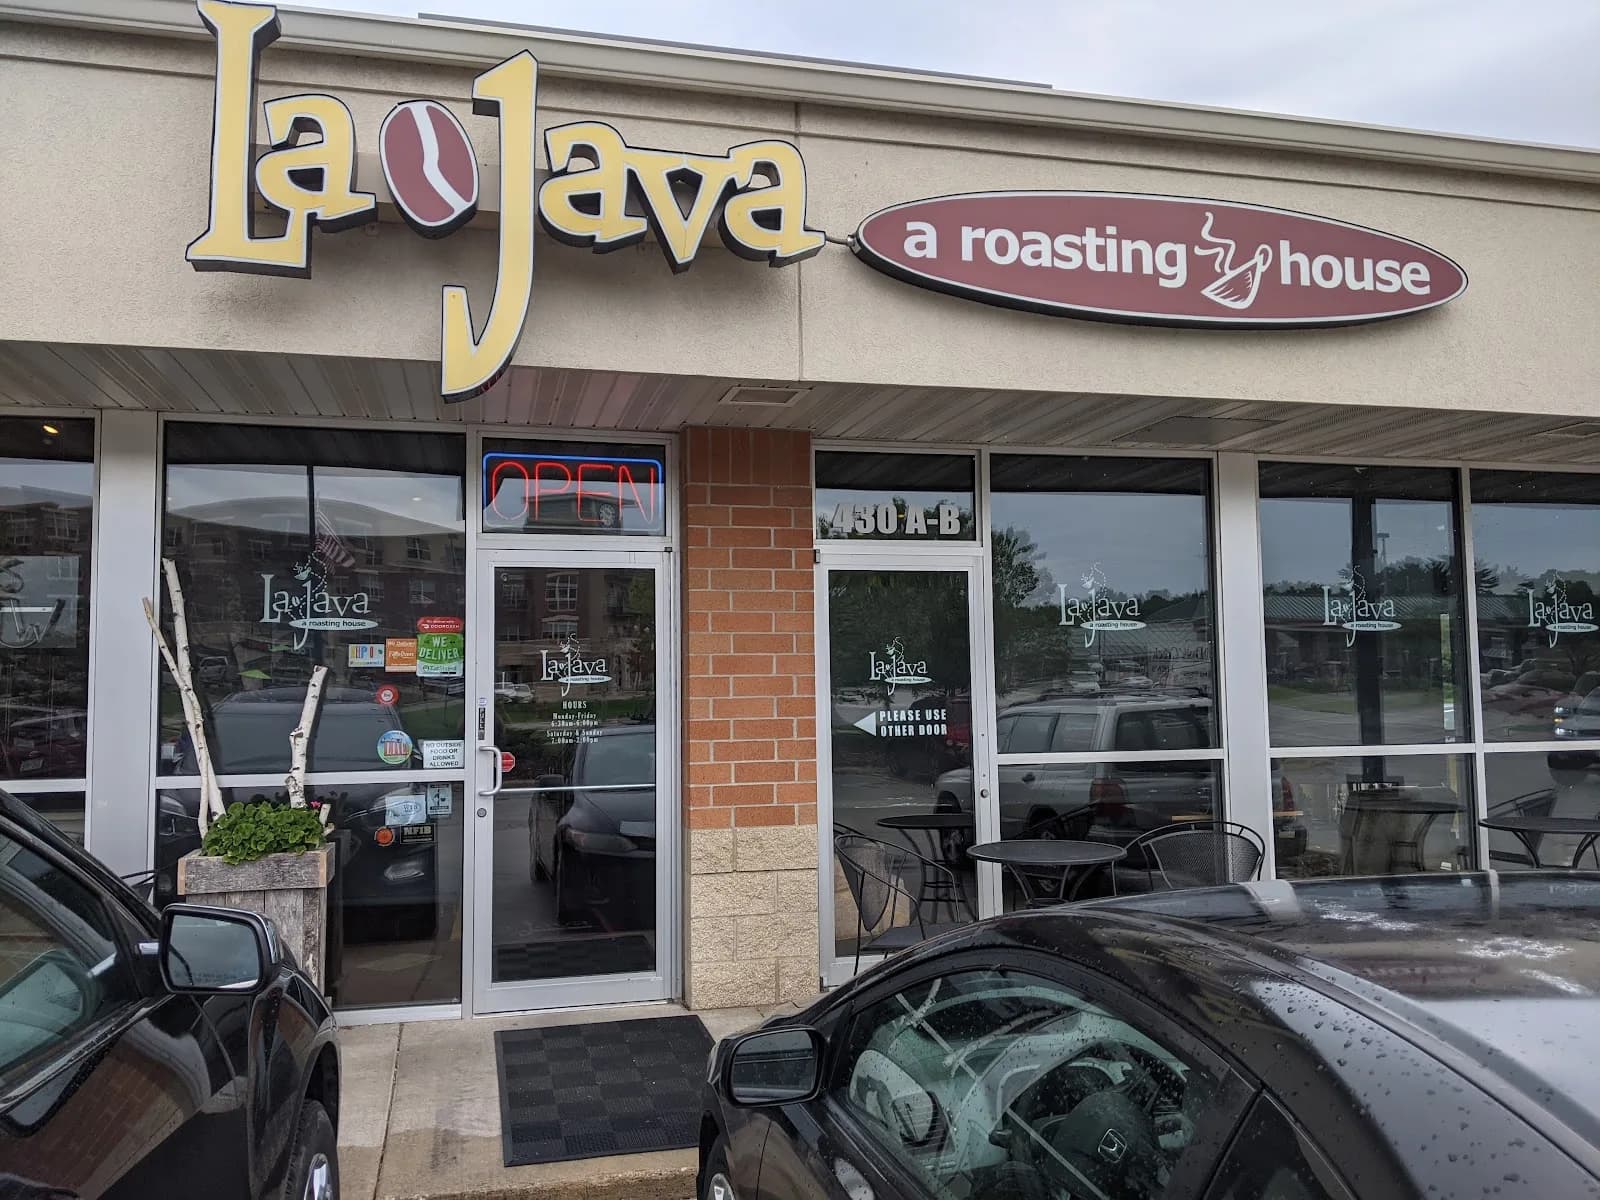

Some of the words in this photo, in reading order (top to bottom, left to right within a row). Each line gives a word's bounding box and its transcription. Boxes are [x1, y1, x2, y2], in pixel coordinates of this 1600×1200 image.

[187, 0, 377, 276] La
[441, 49, 826, 400] Java
[904, 221, 938, 259] a
[960, 224, 1188, 288] roasting
[1280, 240, 1431, 296] house
[491, 461, 656, 524] OPEN
[831, 502, 898, 535] 430
[904, 504, 961, 535] A-B
[259, 573, 292, 623] La
[293, 580, 372, 650] Java
[308, 620, 341, 628] roasting
[1057, 583, 1081, 626] La
[1084, 589, 1141, 648] Java
[1321, 586, 1343, 626] La
[1346, 590, 1397, 648] Java
[1526, 588, 1546, 628] La
[1548, 593, 1595, 649] Java
[419, 647, 460, 661] DELIVER
[432, 636, 448, 648] WE
[540, 649, 559, 681] La
[561, 653, 608, 697] Java
[869, 651, 886, 680] La
[887, 654, 928, 696] Java
[562, 700, 587, 709] HOURS
[879, 709, 921, 722] PLEASE
[925, 709, 947, 721] USE
[880, 725, 915, 737] OTHER
[918, 724, 948, 736] DOOR
